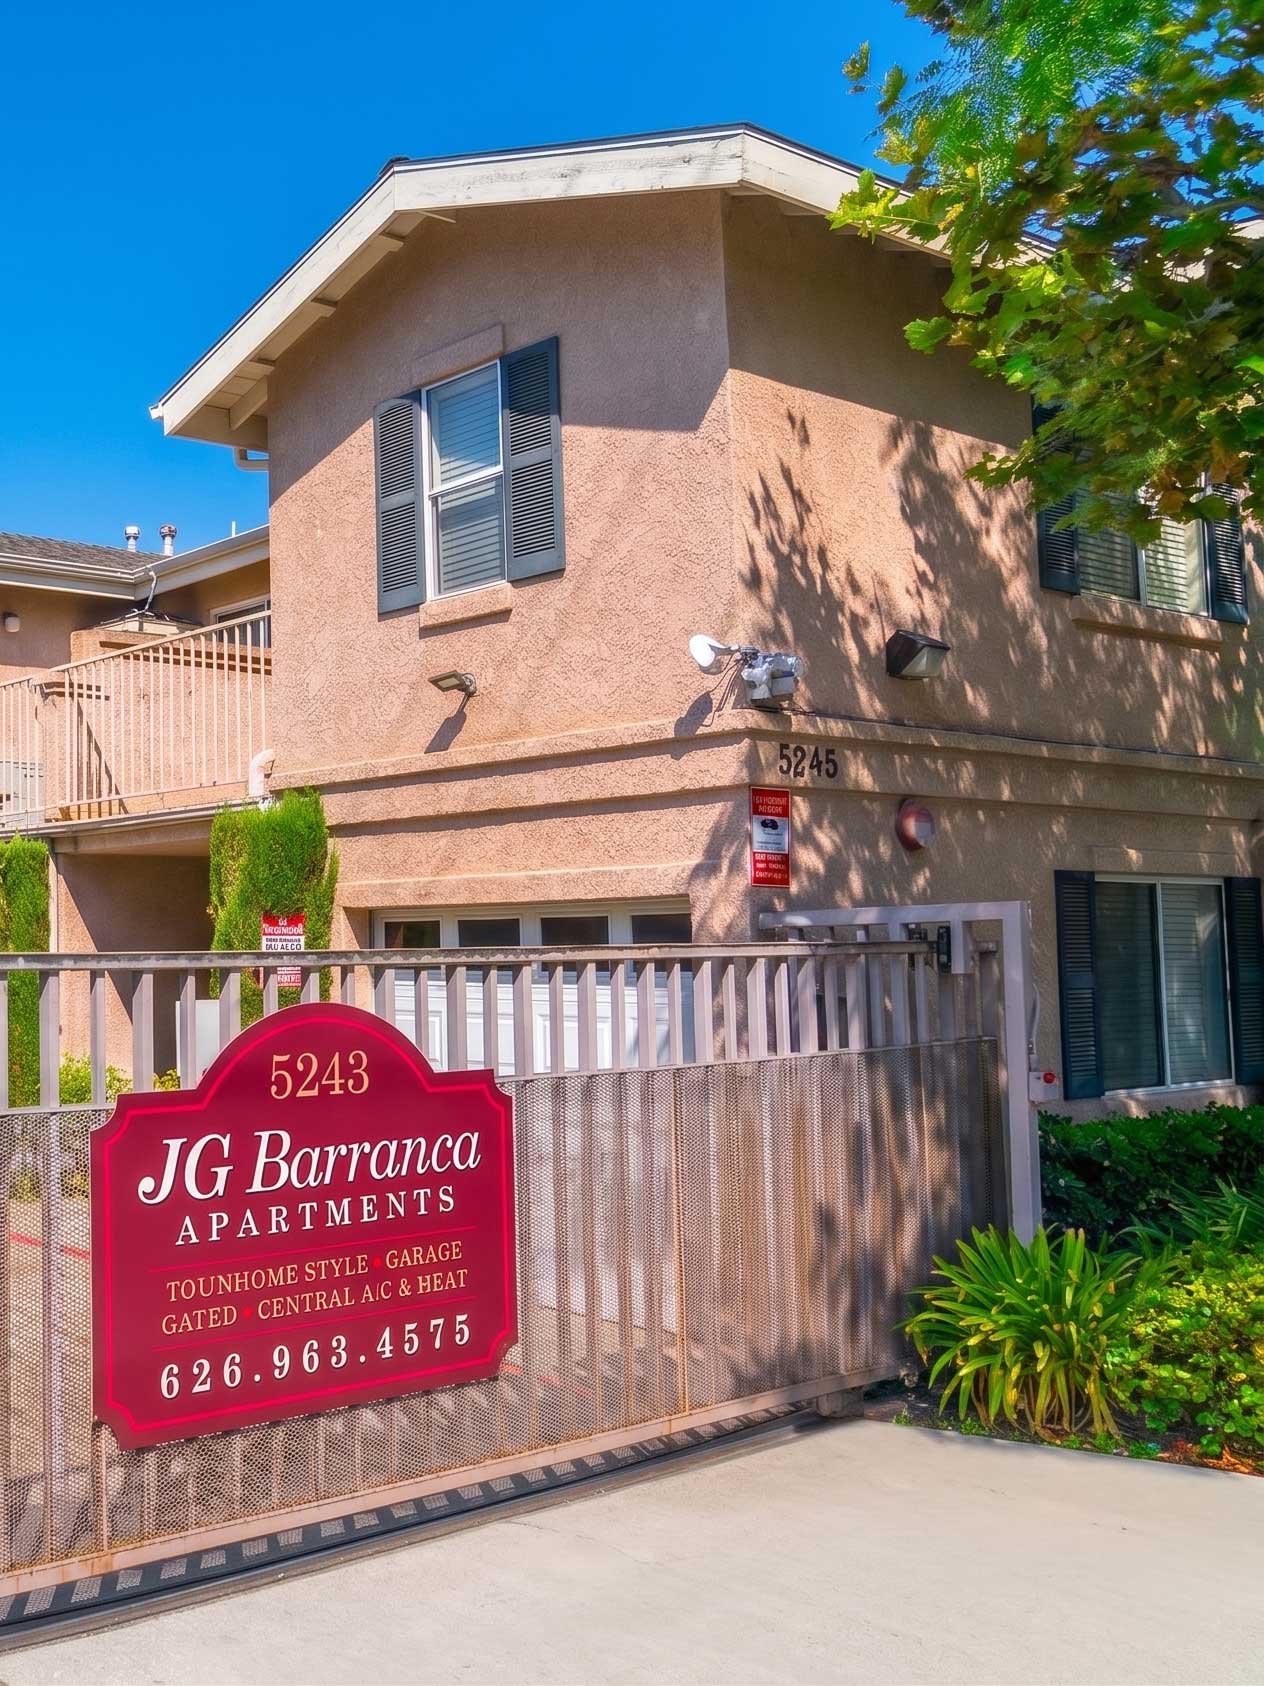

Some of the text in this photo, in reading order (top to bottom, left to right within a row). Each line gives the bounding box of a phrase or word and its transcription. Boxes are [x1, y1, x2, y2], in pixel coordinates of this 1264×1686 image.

[779, 743, 839, 779] 5245
[270, 1050, 370, 1099] 5243
[137, 1129, 482, 1205] JG Barranca
[175, 1185, 456, 1246] APARTMENTS
[304, 1254, 369, 1283] STYLE
[385, 1240, 463, 1272] GARAGE
[161, 1268, 469, 1335] GATED CENTRAL A/C & HEAT
[160, 1313, 472, 1400] 626.963.4575
